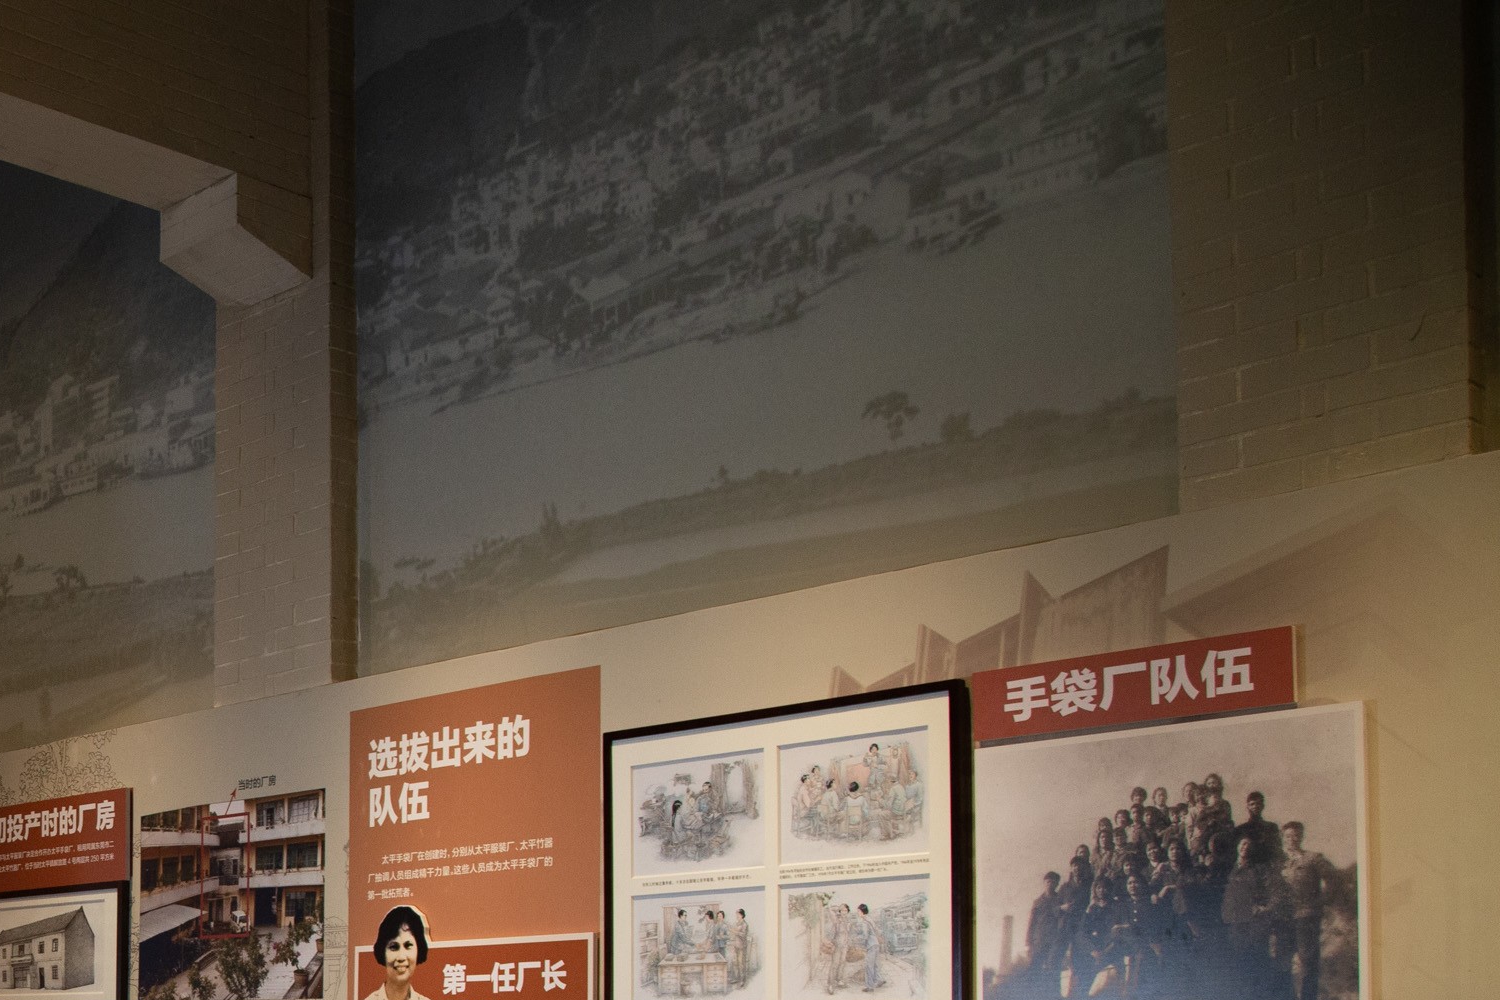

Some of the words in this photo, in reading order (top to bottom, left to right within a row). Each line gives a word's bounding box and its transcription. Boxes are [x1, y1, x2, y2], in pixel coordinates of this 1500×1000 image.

[1003, 646, 1254, 723] 手袋厂队伍
[368, 714, 530, 780] 选拔出来的
[369, 781, 430, 827] 队伍
[442, 959, 567, 995] 第一任厂长
